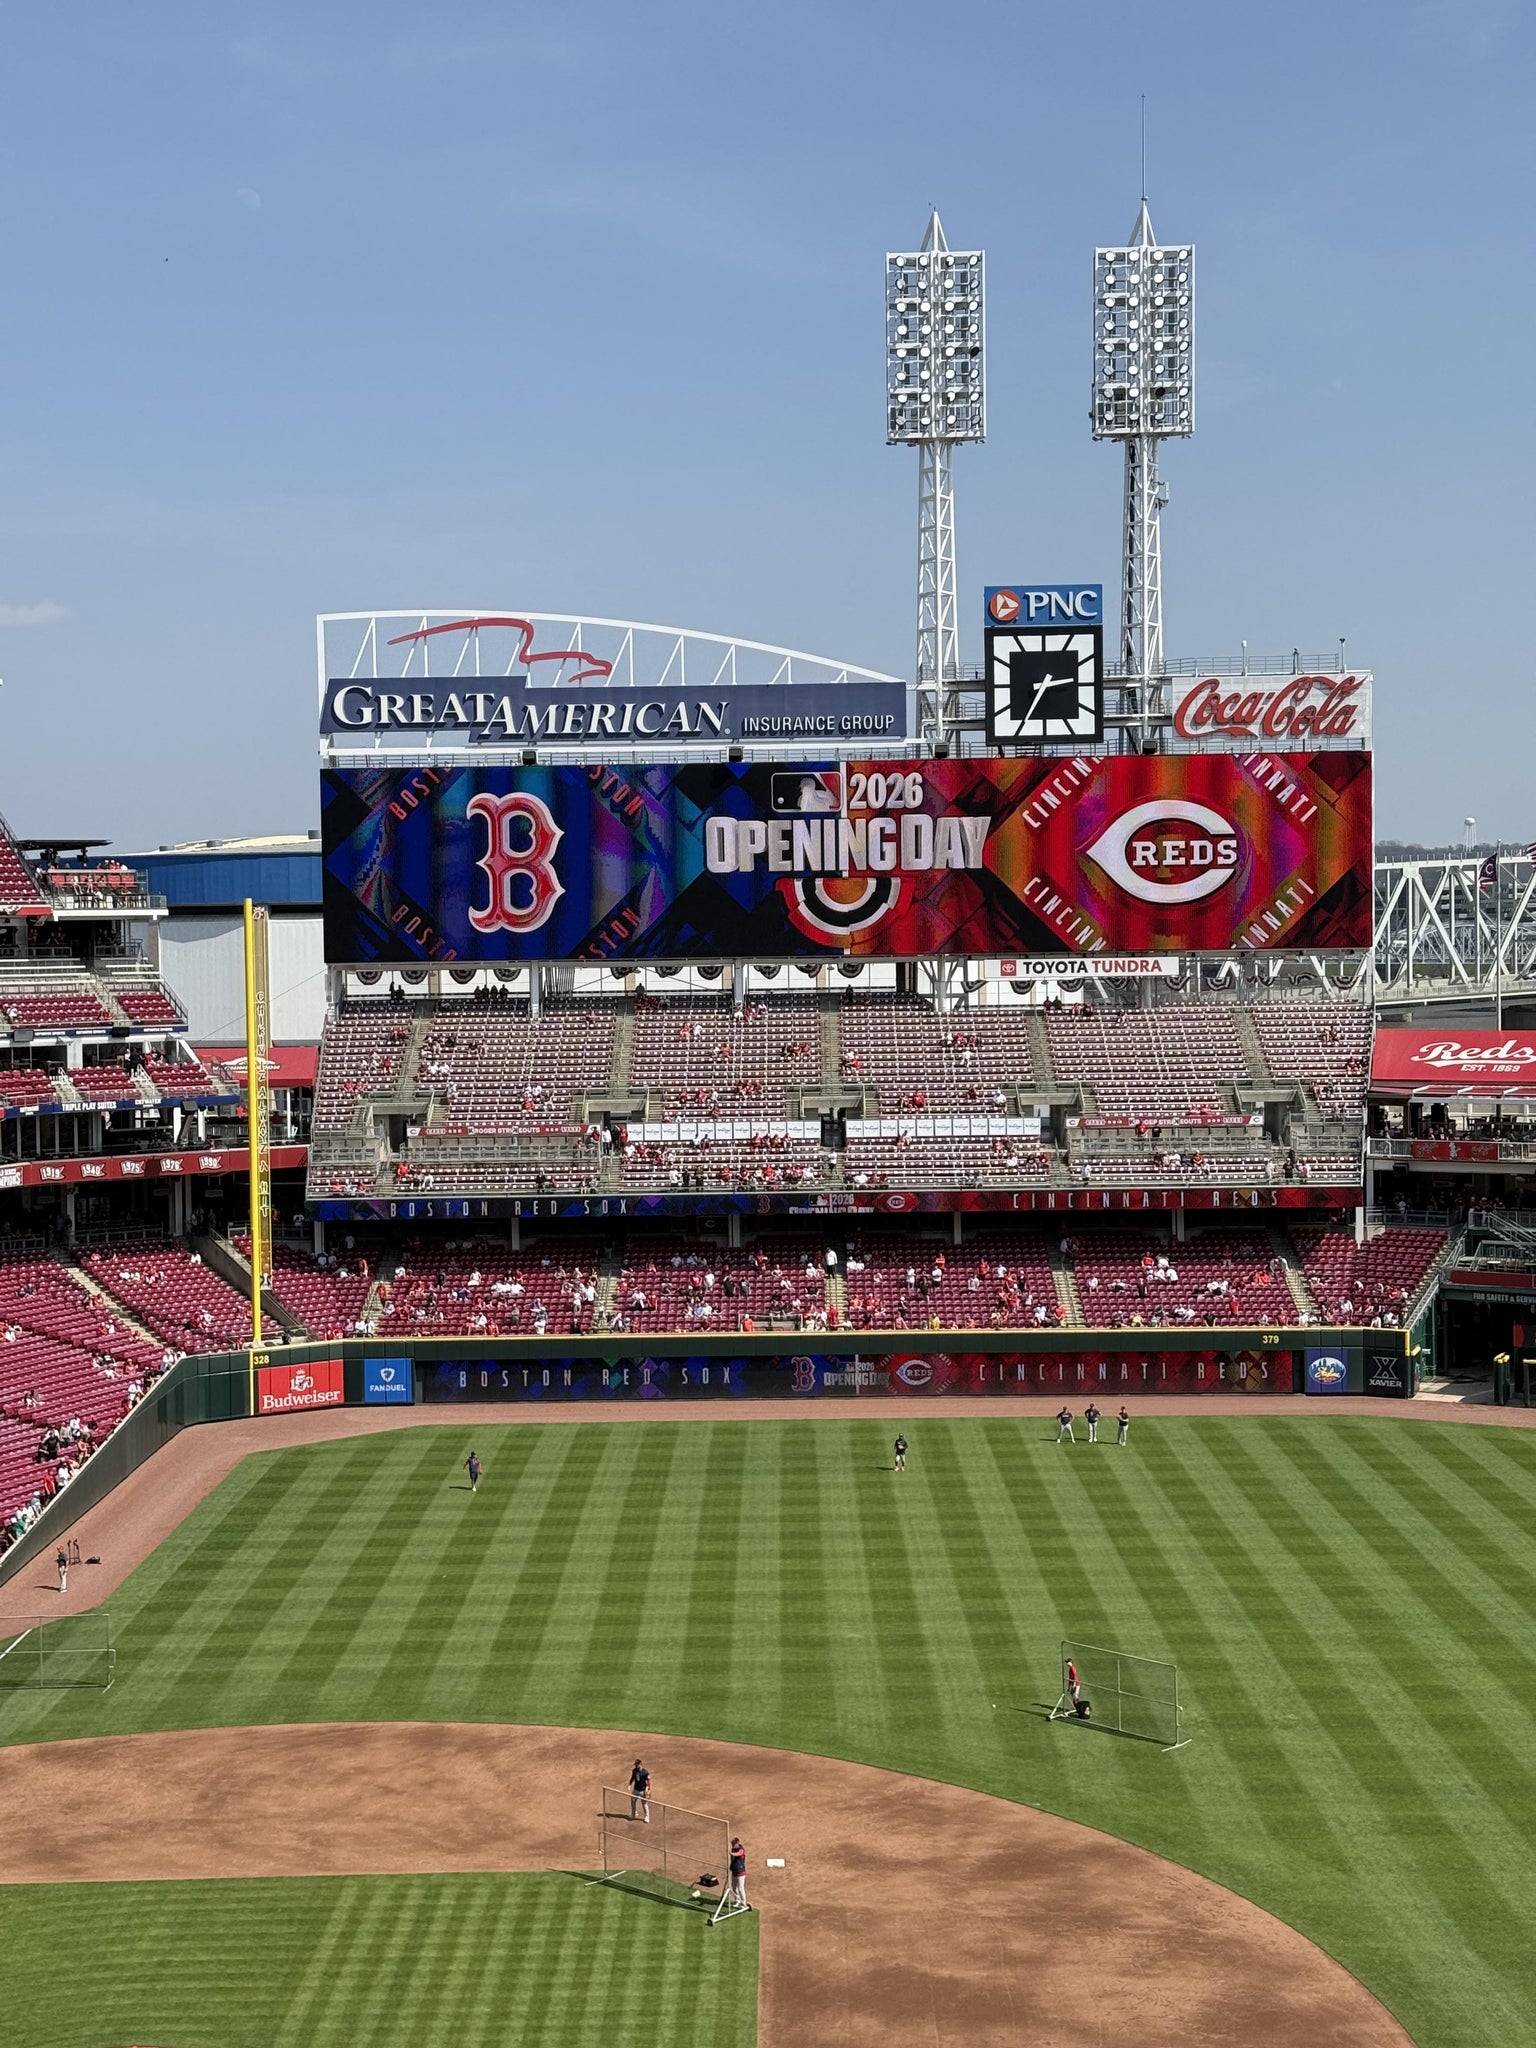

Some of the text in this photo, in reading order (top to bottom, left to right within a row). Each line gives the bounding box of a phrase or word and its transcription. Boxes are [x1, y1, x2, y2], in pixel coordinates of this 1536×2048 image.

[1024, 589, 1098, 618] PNC
[333, 685, 729, 735] GREAT AMERICAN
[1174, 675, 1369, 739] Coca-Cola
[744, 714, 895, 732] INSURANCE GROUP
[850, 772, 924, 809] 2026
[706, 813, 993, 874] OPENING DAY
[1132, 839, 1237, 867] REDS
[466, 792, 566, 933] B
[1023, 959, 1163, 974] TOYOTA TUNDRA
[1410, 1039, 1536, 1068] Reds
[1460, 1064, 1521, 1073] EST. 1869
[62, 1101, 117, 1112] TRIPLE PLAY SUITES
[122, 1161, 141, 1173] 1975
[201, 1156, 217, 1167] 1990
[42, 1167, 61, 1179] 1919
[82, 1164, 100, 1176] 1940
[832, 1194, 855, 1205] 2026
[1013, 1190, 1278, 1209] CINCINNATI REDS
[390, 1199, 627, 1217] BOSTON RED SOX
[1473, 1292, 1486, 1300] FOR
[1486, 1293, 1509, 1302] SAFETY
[1262, 1335, 1279, 1344] 379
[253, 1355, 270, 1365] 328
[857, 1361, 875, 1371] 2026
[459, 1367, 730, 1388] BOSTON RED SOX
[791, 1356, 816, 1392] B
[906, 1369, 934, 1377] REDS
[979, 1362, 1268, 1381] CINCINNATI REDS
[823, 1372, 869, 1387] OPENING
[1368, 1378, 1402, 1388] XAVIER
[369, 1384, 406, 1392] FANDUEL
[262, 1390, 341, 1410] Budweiser
